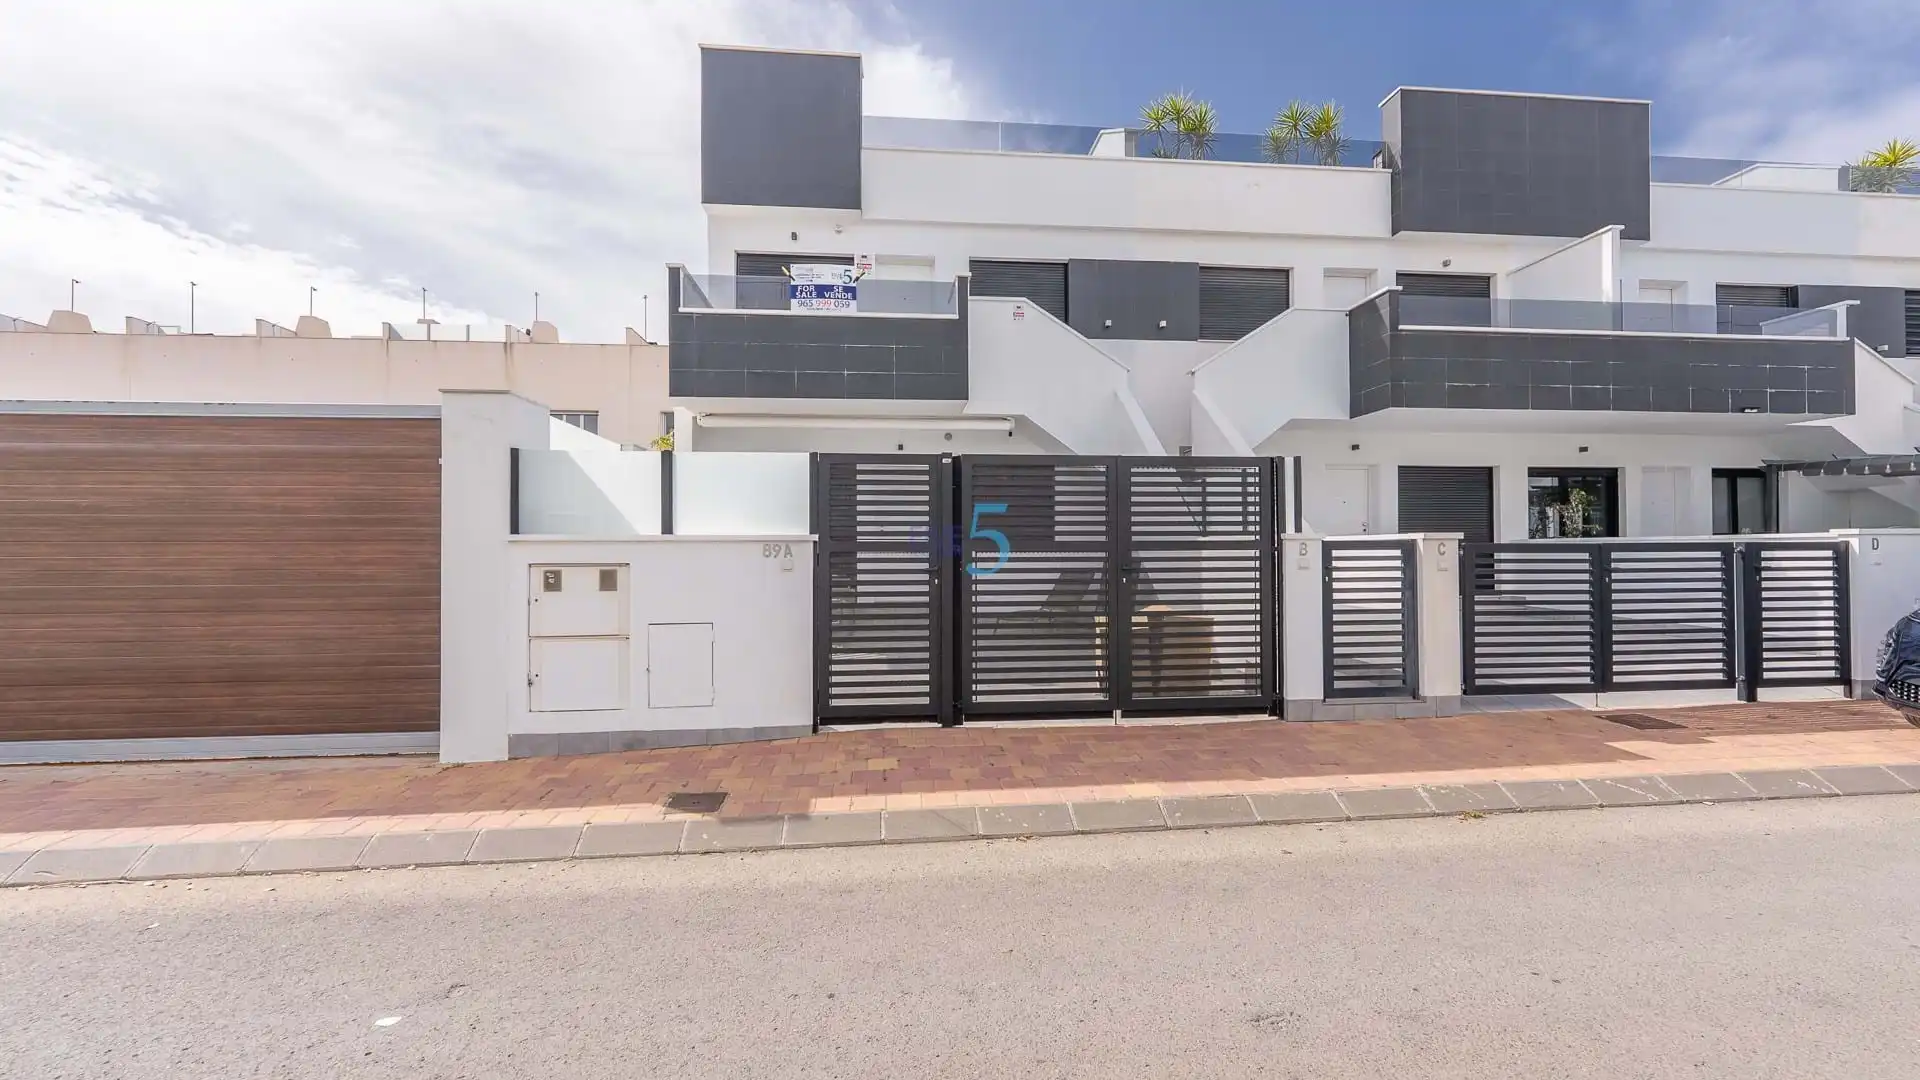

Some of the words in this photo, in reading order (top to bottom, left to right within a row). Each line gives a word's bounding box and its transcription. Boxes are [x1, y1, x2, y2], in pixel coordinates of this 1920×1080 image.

[842, 269, 853, 284] 5
[795, 291, 817, 299] SALE
[824, 291, 853, 299] VENDE
[797, 299, 814, 308] 965
[816, 299, 832, 308] 999
[833, 300, 851, 309] 059
[1299, 542, 1308, 556] B
[1437, 542, 1446, 556] C
[1871, 537, 1879, 550] D
